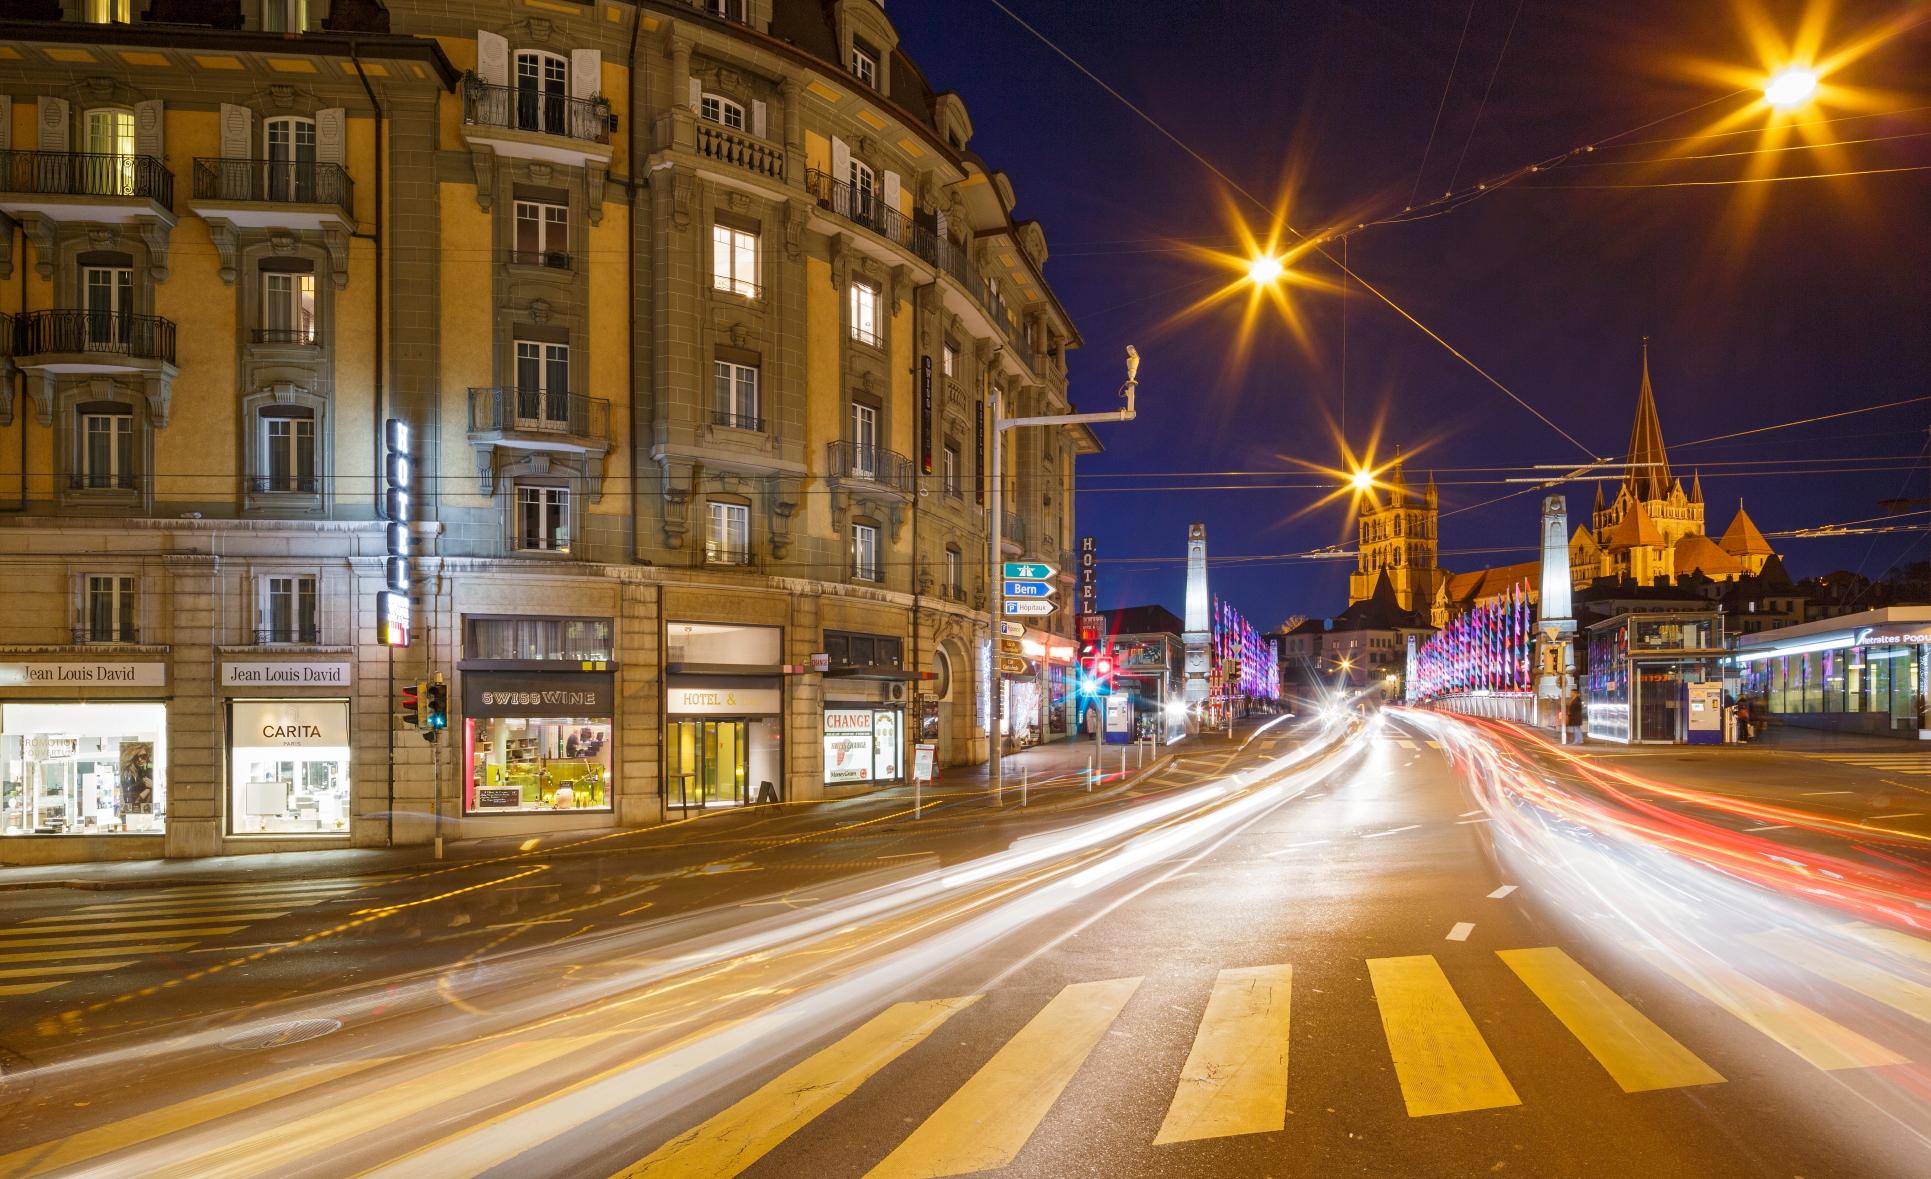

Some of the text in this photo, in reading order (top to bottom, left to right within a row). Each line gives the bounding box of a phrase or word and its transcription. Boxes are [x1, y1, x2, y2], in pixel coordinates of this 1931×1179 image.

[397, 421, 409, 588] HOTEL
[1083, 537, 1093, 614] HOTEL
[1014, 583, 1037, 595] Bern
[1862, 635, 1901, 645] Retraites
[23, 665, 135, 681] Jean Louis David
[230, 666, 341, 681] Jean Louis David
[683, 693, 721, 705] HOTEL
[826, 714, 870, 728] CHANGE
[262, 725, 322, 738] CARITA
